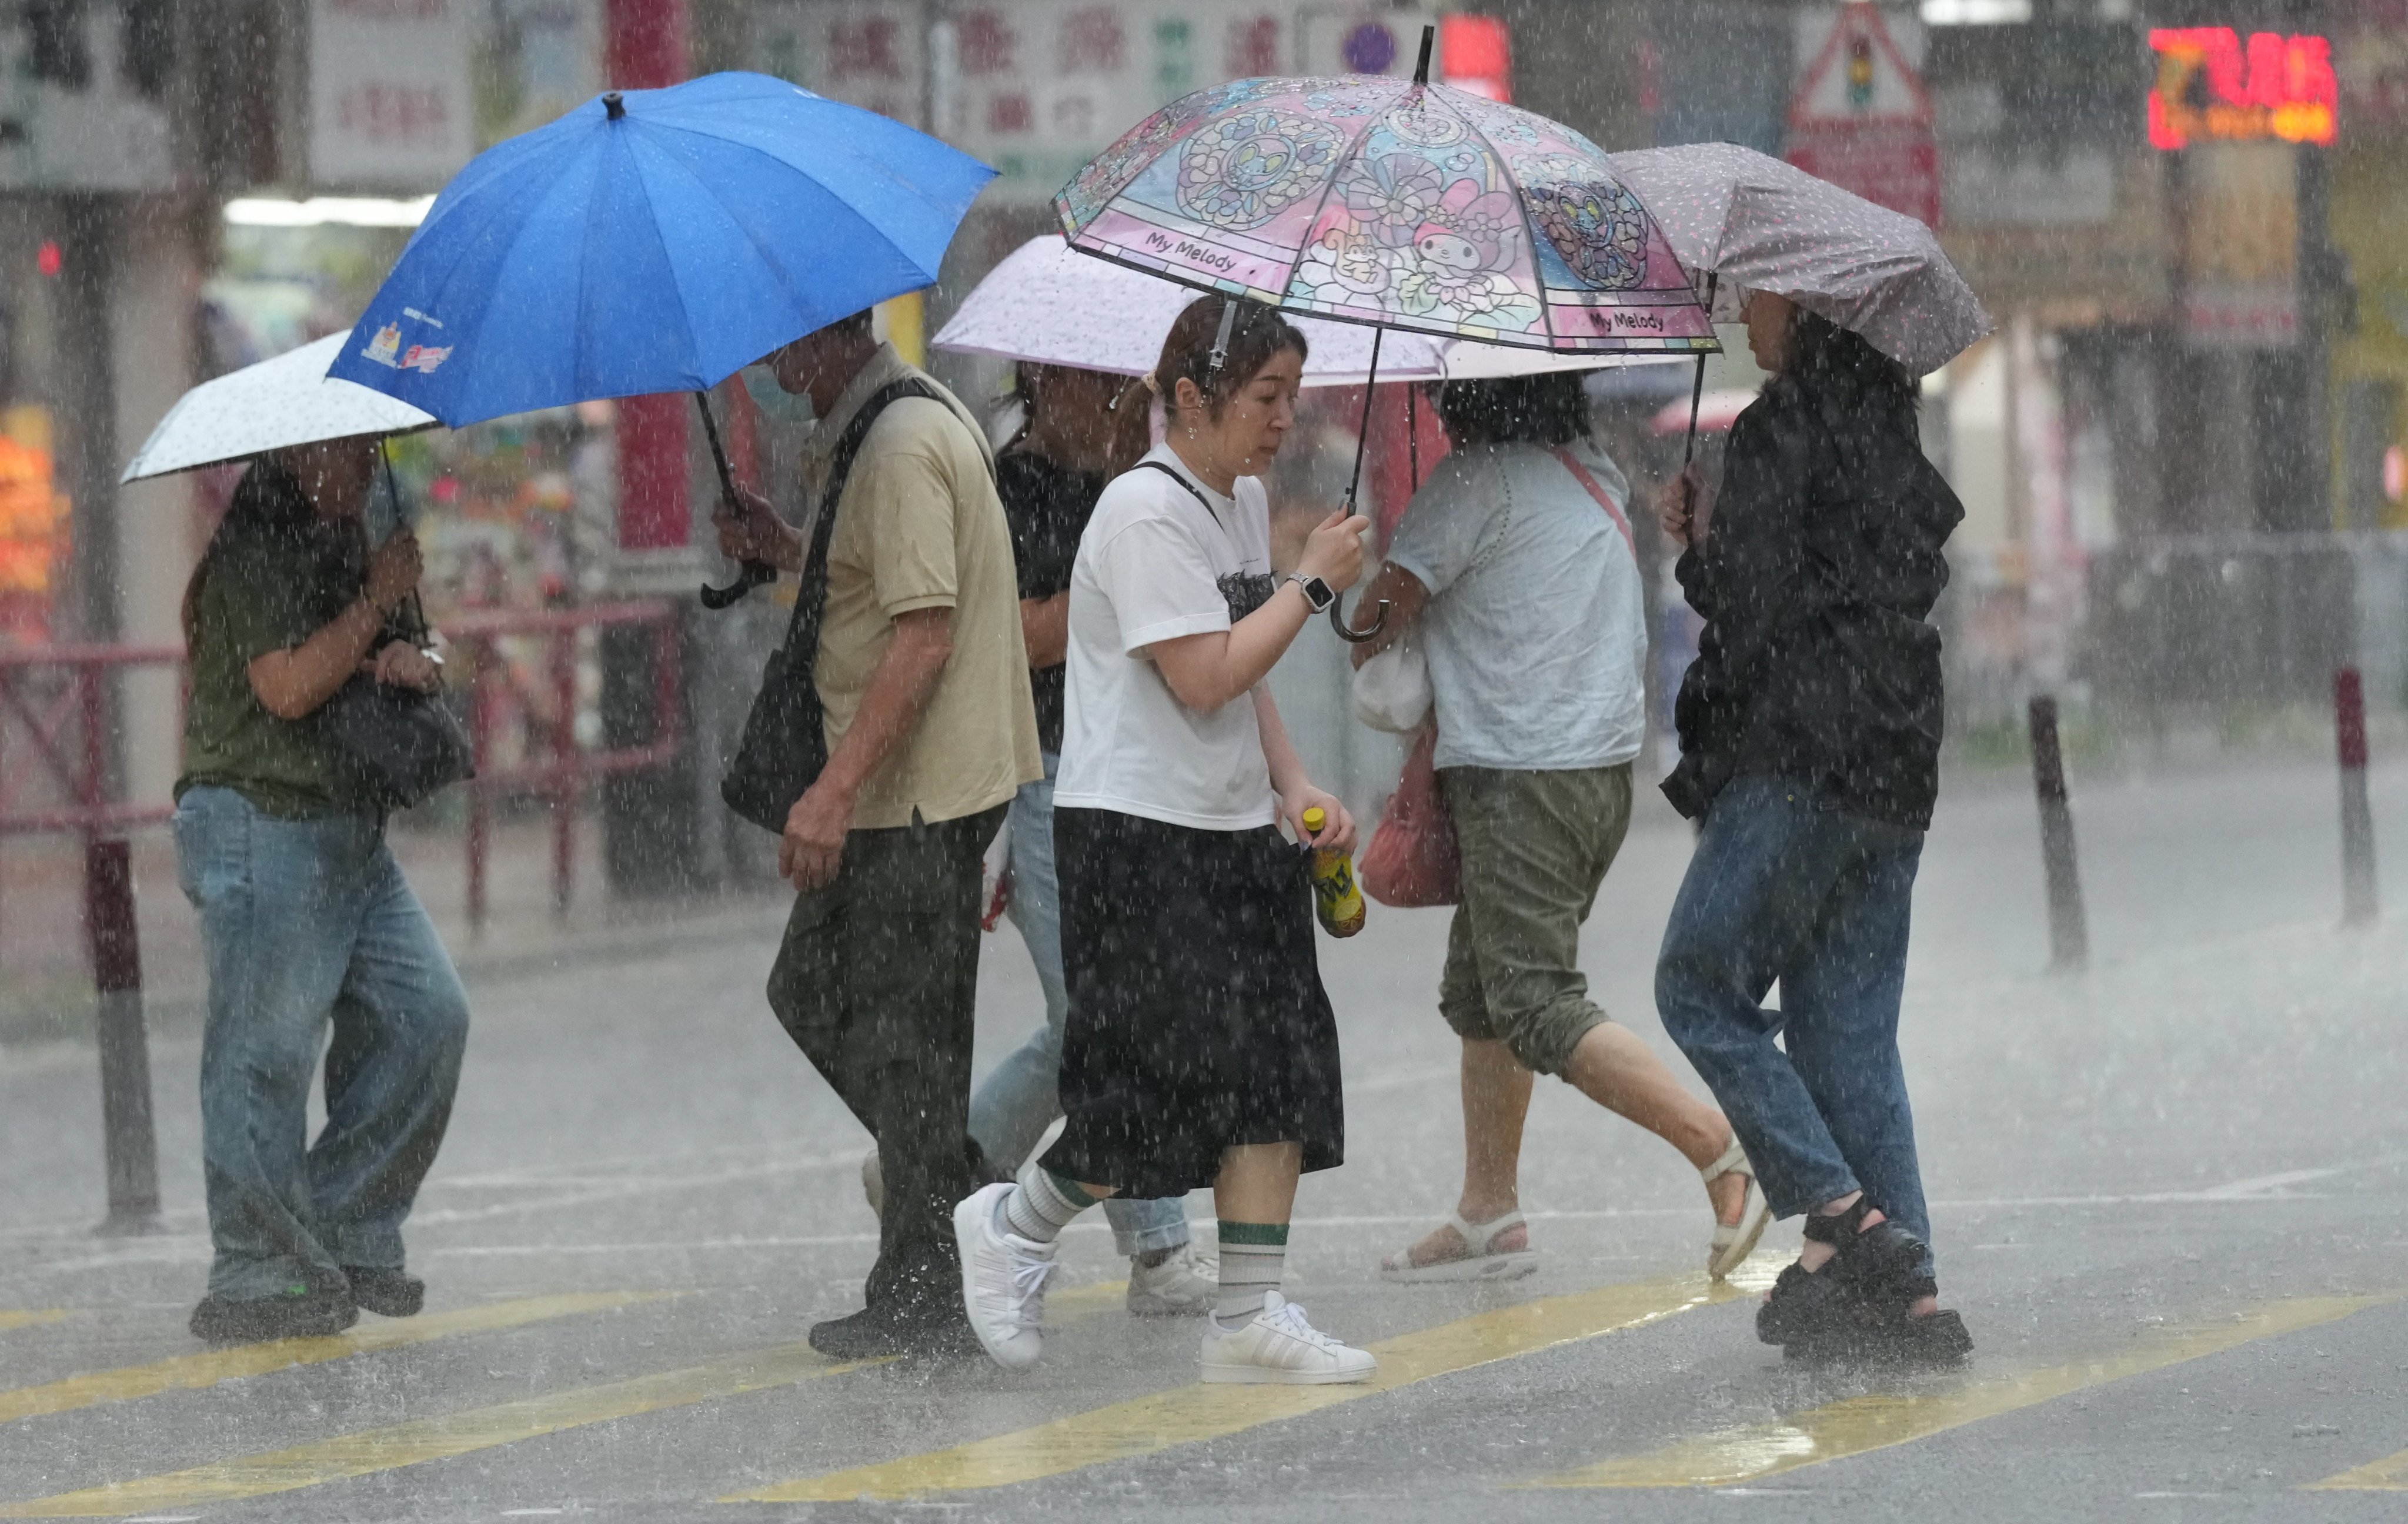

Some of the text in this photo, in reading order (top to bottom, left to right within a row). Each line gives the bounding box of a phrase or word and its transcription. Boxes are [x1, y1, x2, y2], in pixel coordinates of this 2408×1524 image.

[1145, 232, 1237, 272] My Melody
[1589, 312, 1663, 332] My Melody
